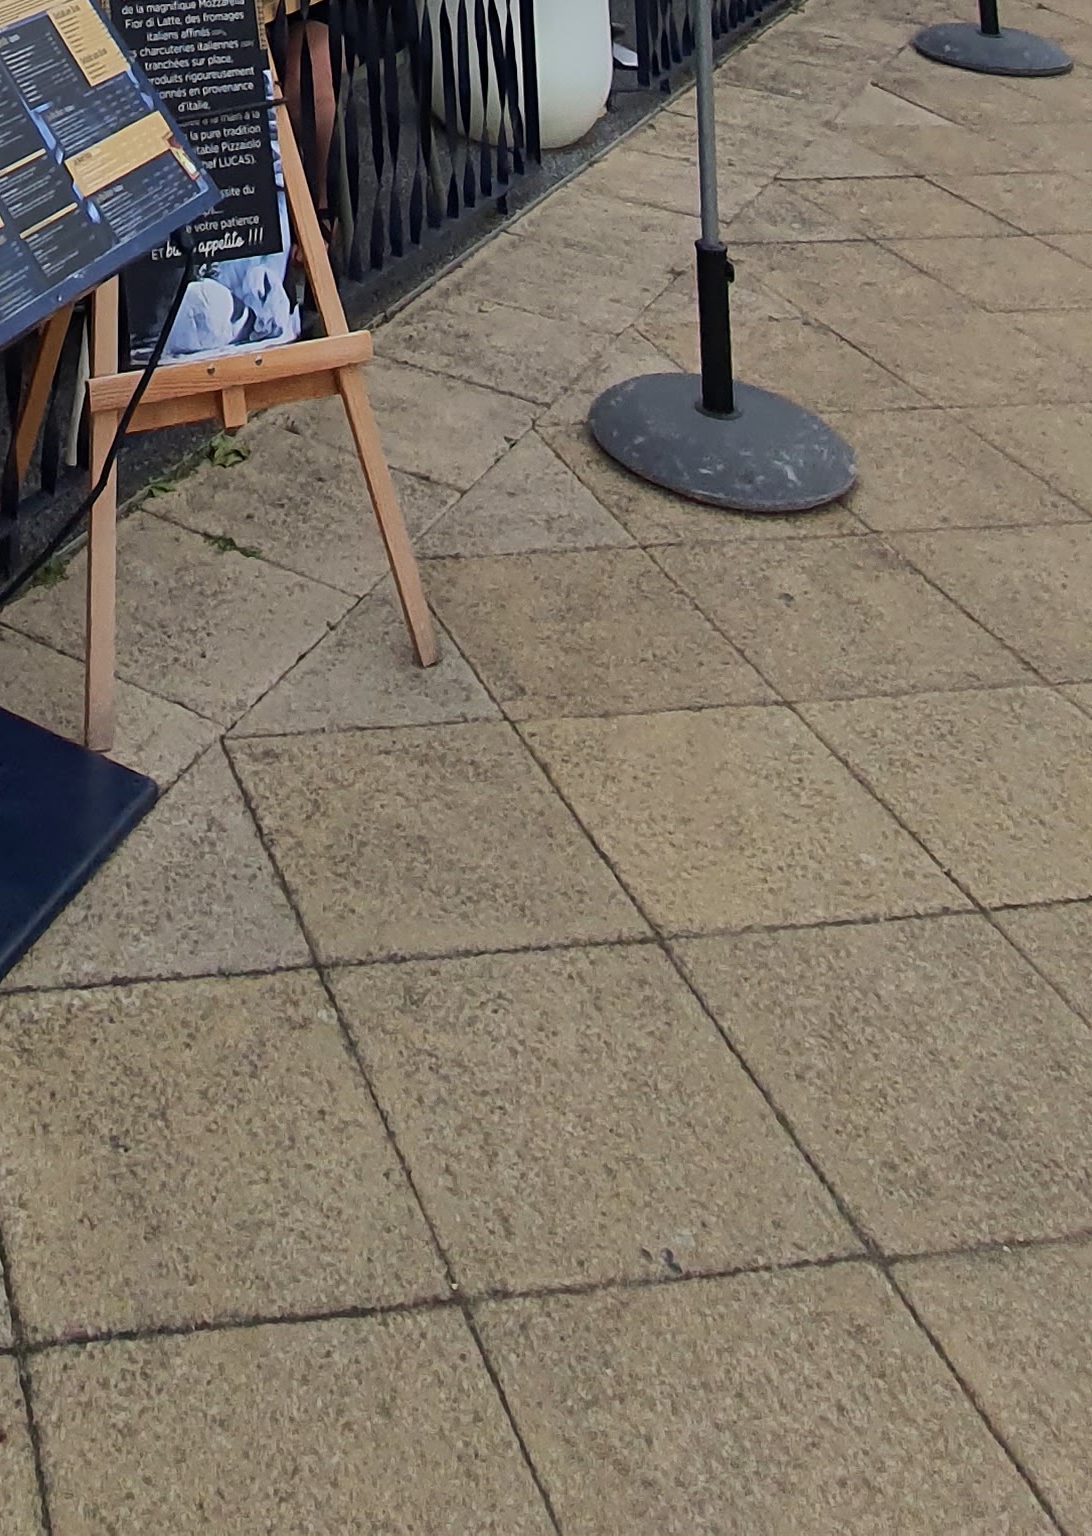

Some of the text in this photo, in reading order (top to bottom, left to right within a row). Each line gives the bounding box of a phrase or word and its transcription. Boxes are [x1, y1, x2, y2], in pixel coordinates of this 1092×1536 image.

[121, 5, 134, 15] de
[136, 3, 144, 14] la
[146, 0, 196, 13] magnifique
[146, 16, 155, 27] di
[184, 14, 201, 24] des
[203, 11, 244, 23] fromages
[181, 28, 210, 38] affinés
[139, 42, 195, 57] charcuteries
[145, 58, 189, 71] tranchées
[192, 57, 205, 67] sur
[148, 66, 255, 85] roduits rigoureusement
[188, 86, 201, 97] en
[202, 81, 254, 96] provenance
[251, 110, 261, 119] la
[189, 124, 261, 142] la pure tradition
[221, 138, 262, 152] Pizzaiolo
[243, 184, 255, 195] du
[194, 221, 219, 232] votre
[220, 215, 260, 229] patience
[151, 247, 165, 260] ET
[198, 231, 245, 258] appetito
